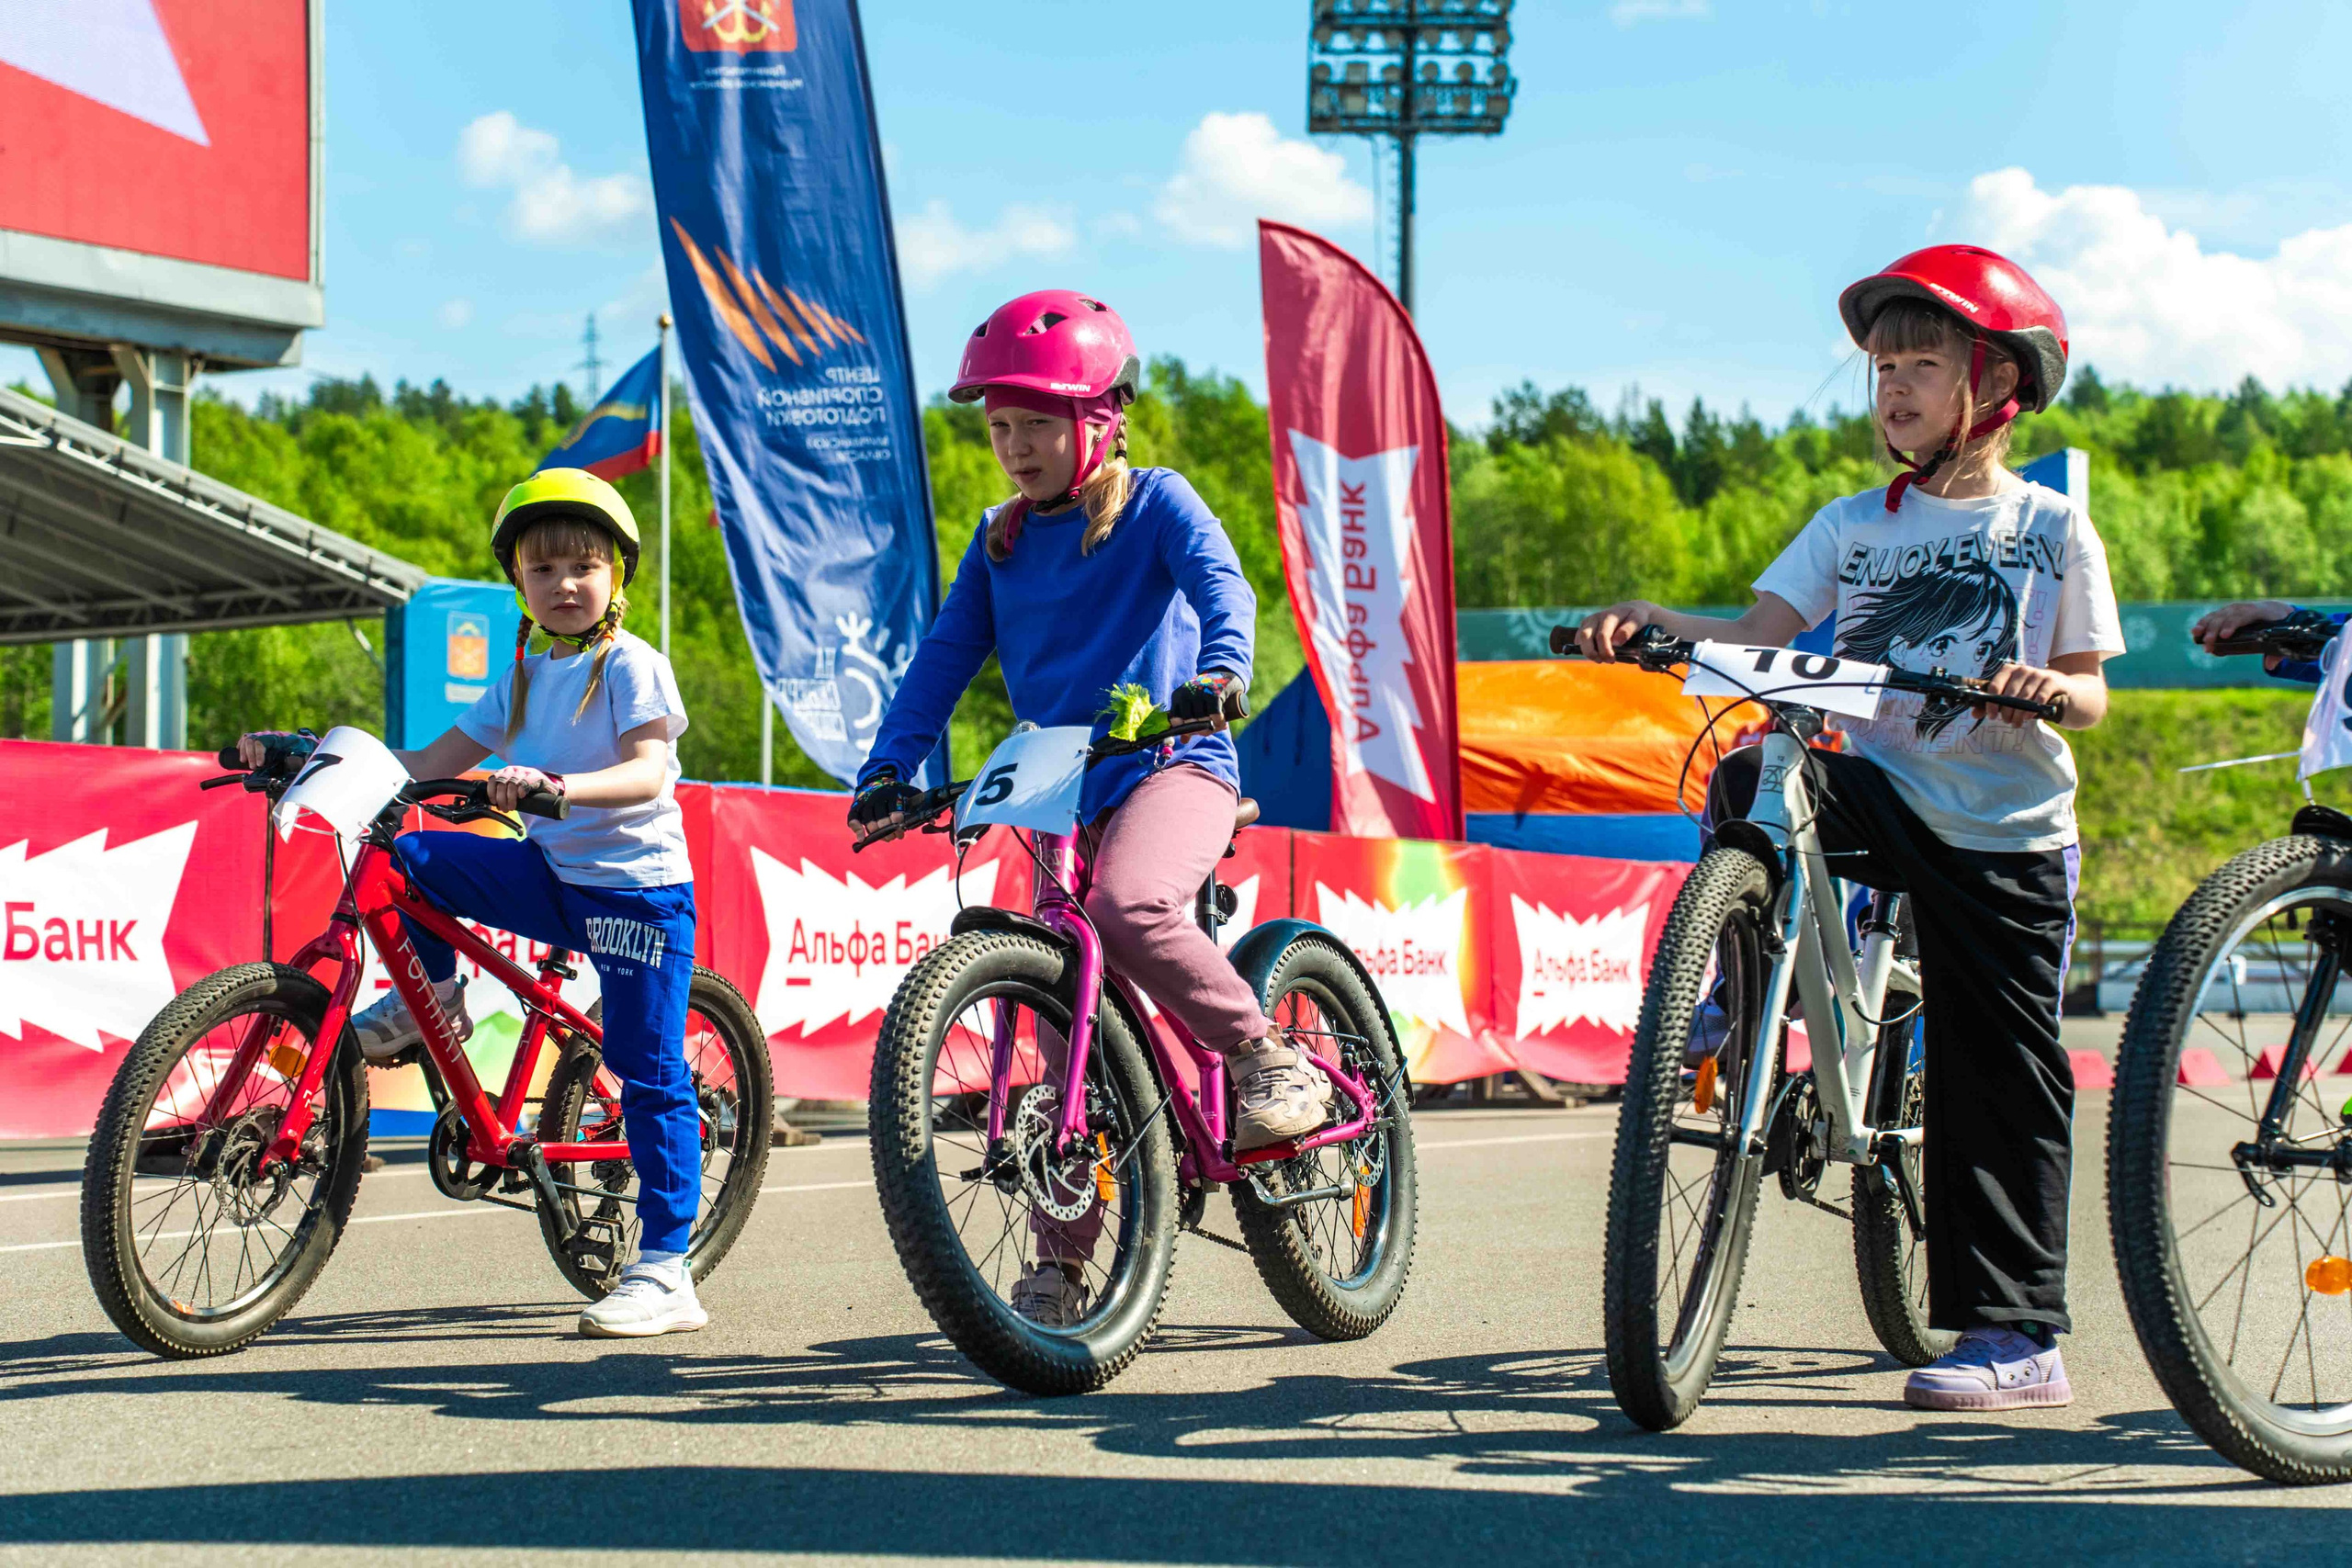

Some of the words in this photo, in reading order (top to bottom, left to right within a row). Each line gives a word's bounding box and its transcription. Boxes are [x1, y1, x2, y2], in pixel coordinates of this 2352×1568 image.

[1838, 538, 1950, 586] ENJOY
[1952, 530, 2064, 581] EVERY
[1743, 648, 1841, 681] 10
[292, 752, 345, 786] 7
[974, 762, 1019, 807] 5
[3, 901, 140, 962] Банк
[585, 917, 667, 969] BROOKLYN
[788, 918, 887, 978] Альфа
[617, 966, 634, 976] YORK
[1343, 938, 1397, 985] льфа
[1403, 940, 1449, 976] Банк
[1532, 949, 1588, 989] Альфа
[1590, 948, 1632, 983] Банк
